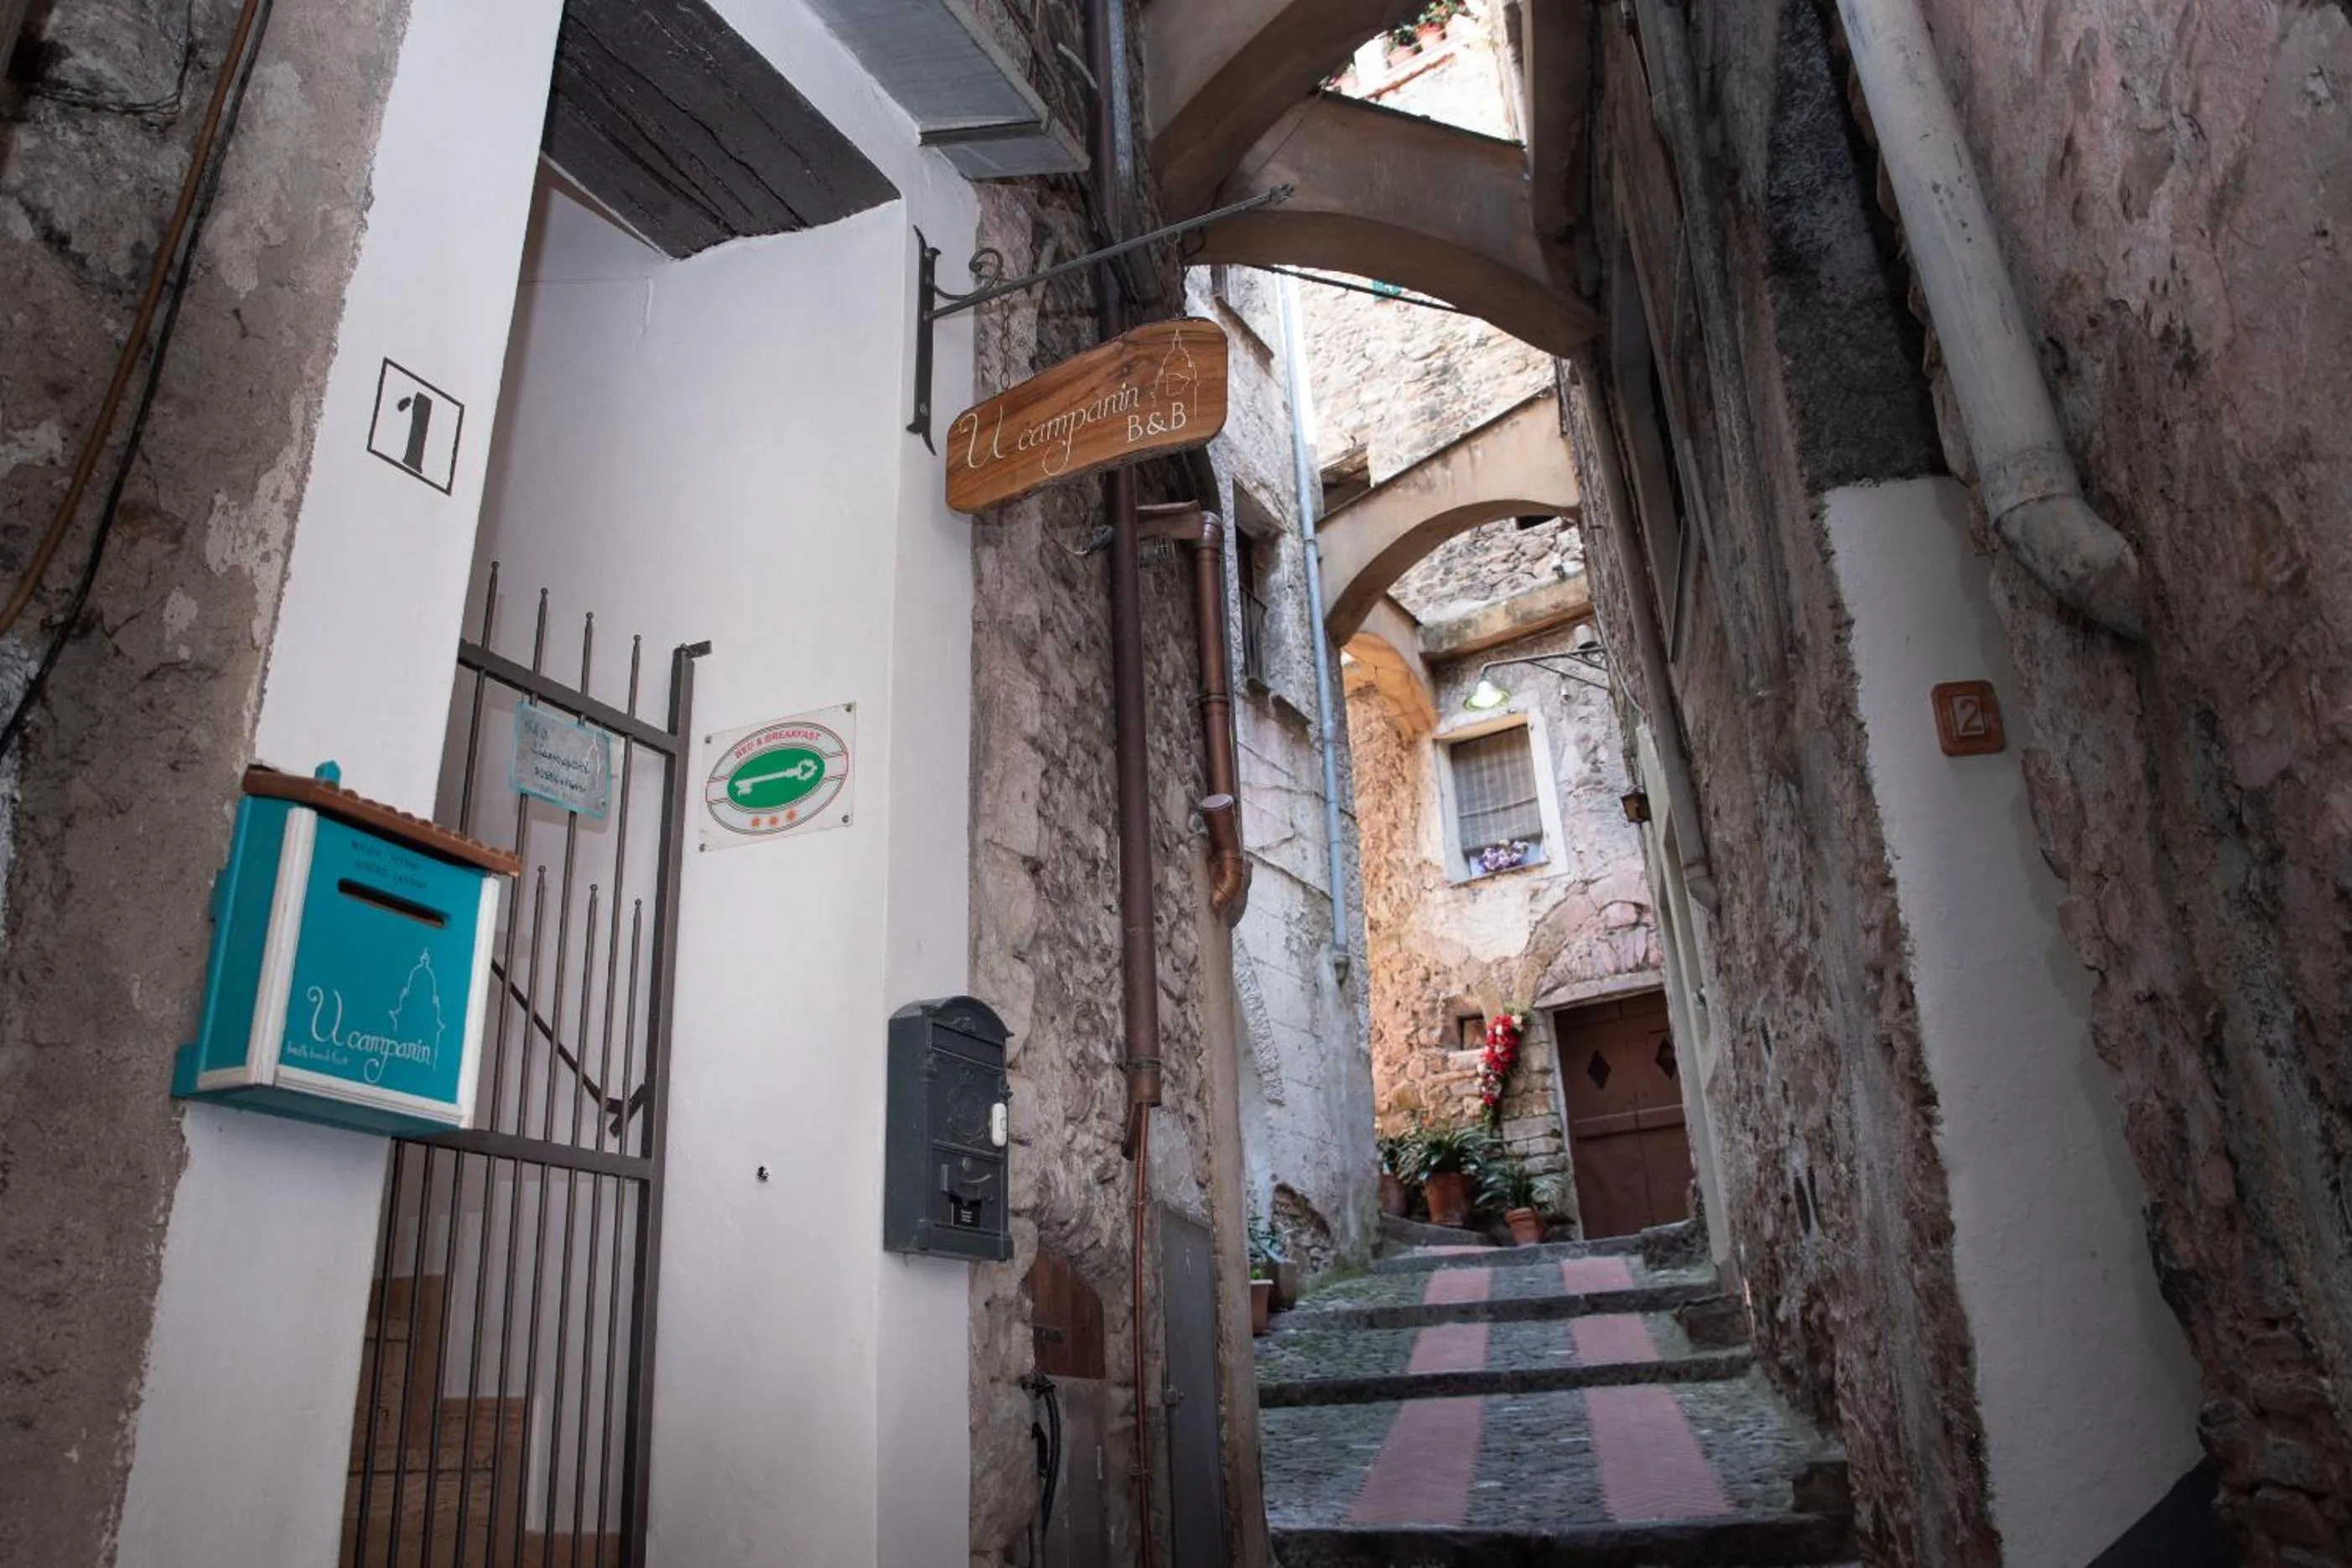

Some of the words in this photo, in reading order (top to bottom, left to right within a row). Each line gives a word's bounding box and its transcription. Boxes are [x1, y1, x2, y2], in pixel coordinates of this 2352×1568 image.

[397, 392, 432, 474] 1
[1018, 382, 1140, 476] campanin
[1127, 402, 1186, 443] B&B
[1960, 698, 1982, 732] 2
[735, 741, 755, 759] BED
[765, 729, 820, 743] BREAKFAST
[346, 1031, 433, 1083] campanin
